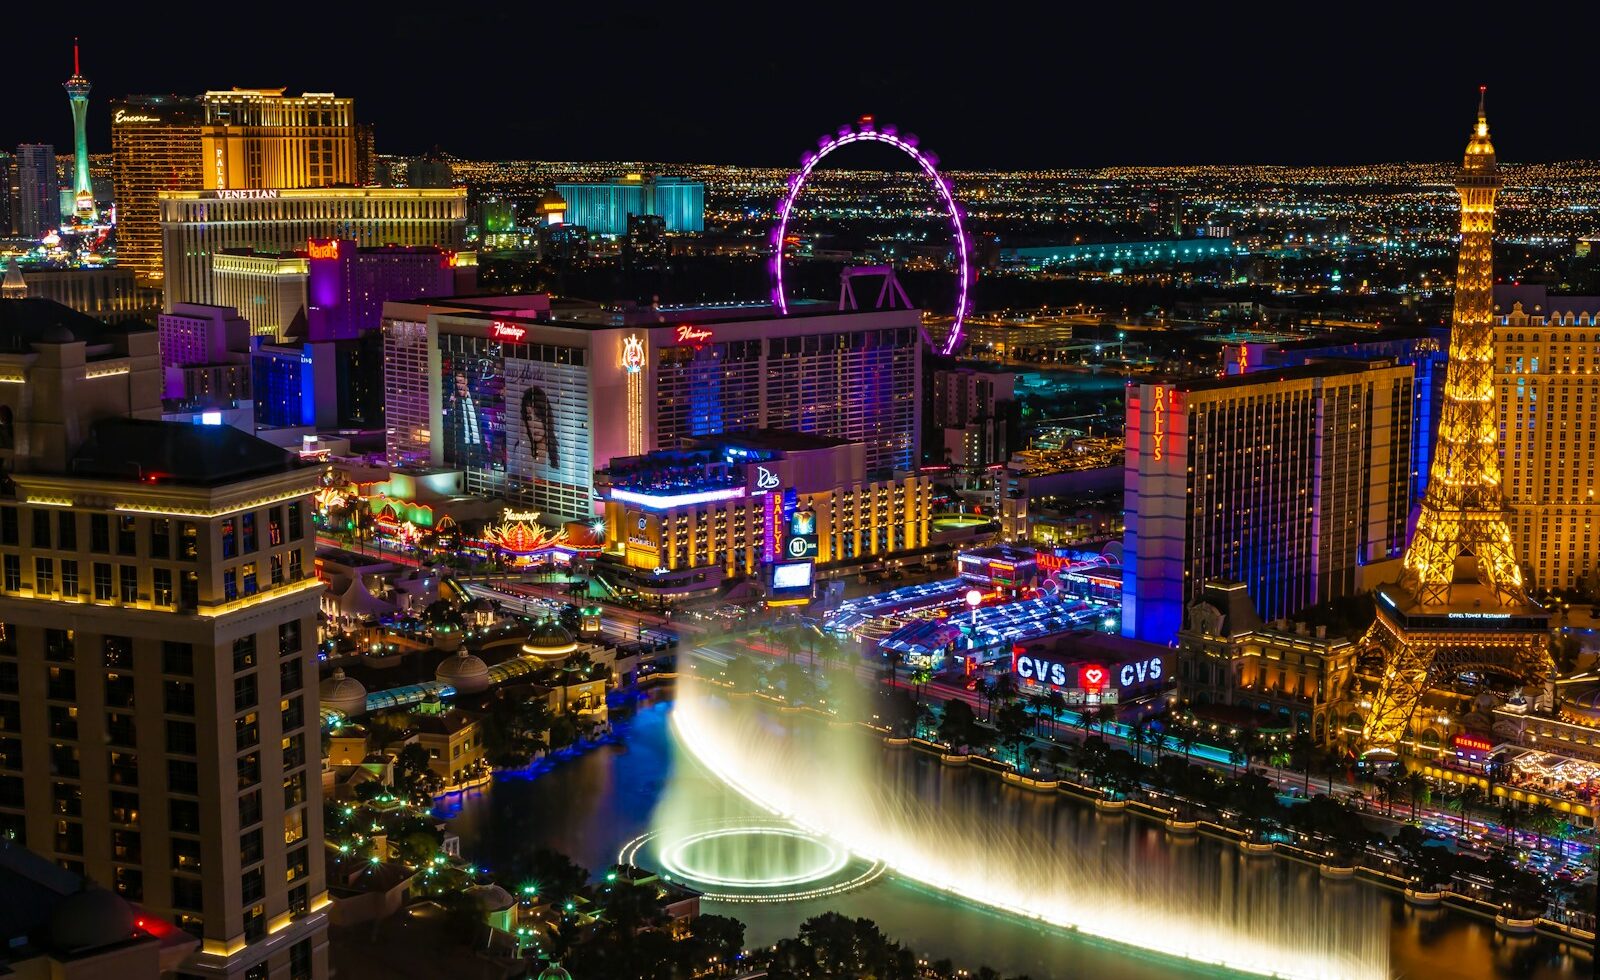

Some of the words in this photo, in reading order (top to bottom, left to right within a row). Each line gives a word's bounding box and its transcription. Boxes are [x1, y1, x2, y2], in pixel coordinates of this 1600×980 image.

[115, 110, 160, 124] Encore
[216, 189, 278, 199] VENETIAN
[493, 321, 526, 341] Flamingo
[676, 325, 713, 341] Flamingo
[1152, 386, 1165, 461] BALLYS
[503, 507, 541, 525] Flamingo
[773, 494, 783, 554] BALLYS
[628, 536, 657, 549] CROMWELL
[1017, 656, 1066, 686] CVS
[1120, 657, 1162, 687] CVS
[1455, 737, 1473, 747] BEER
[1473, 741, 1491, 751] PARK
